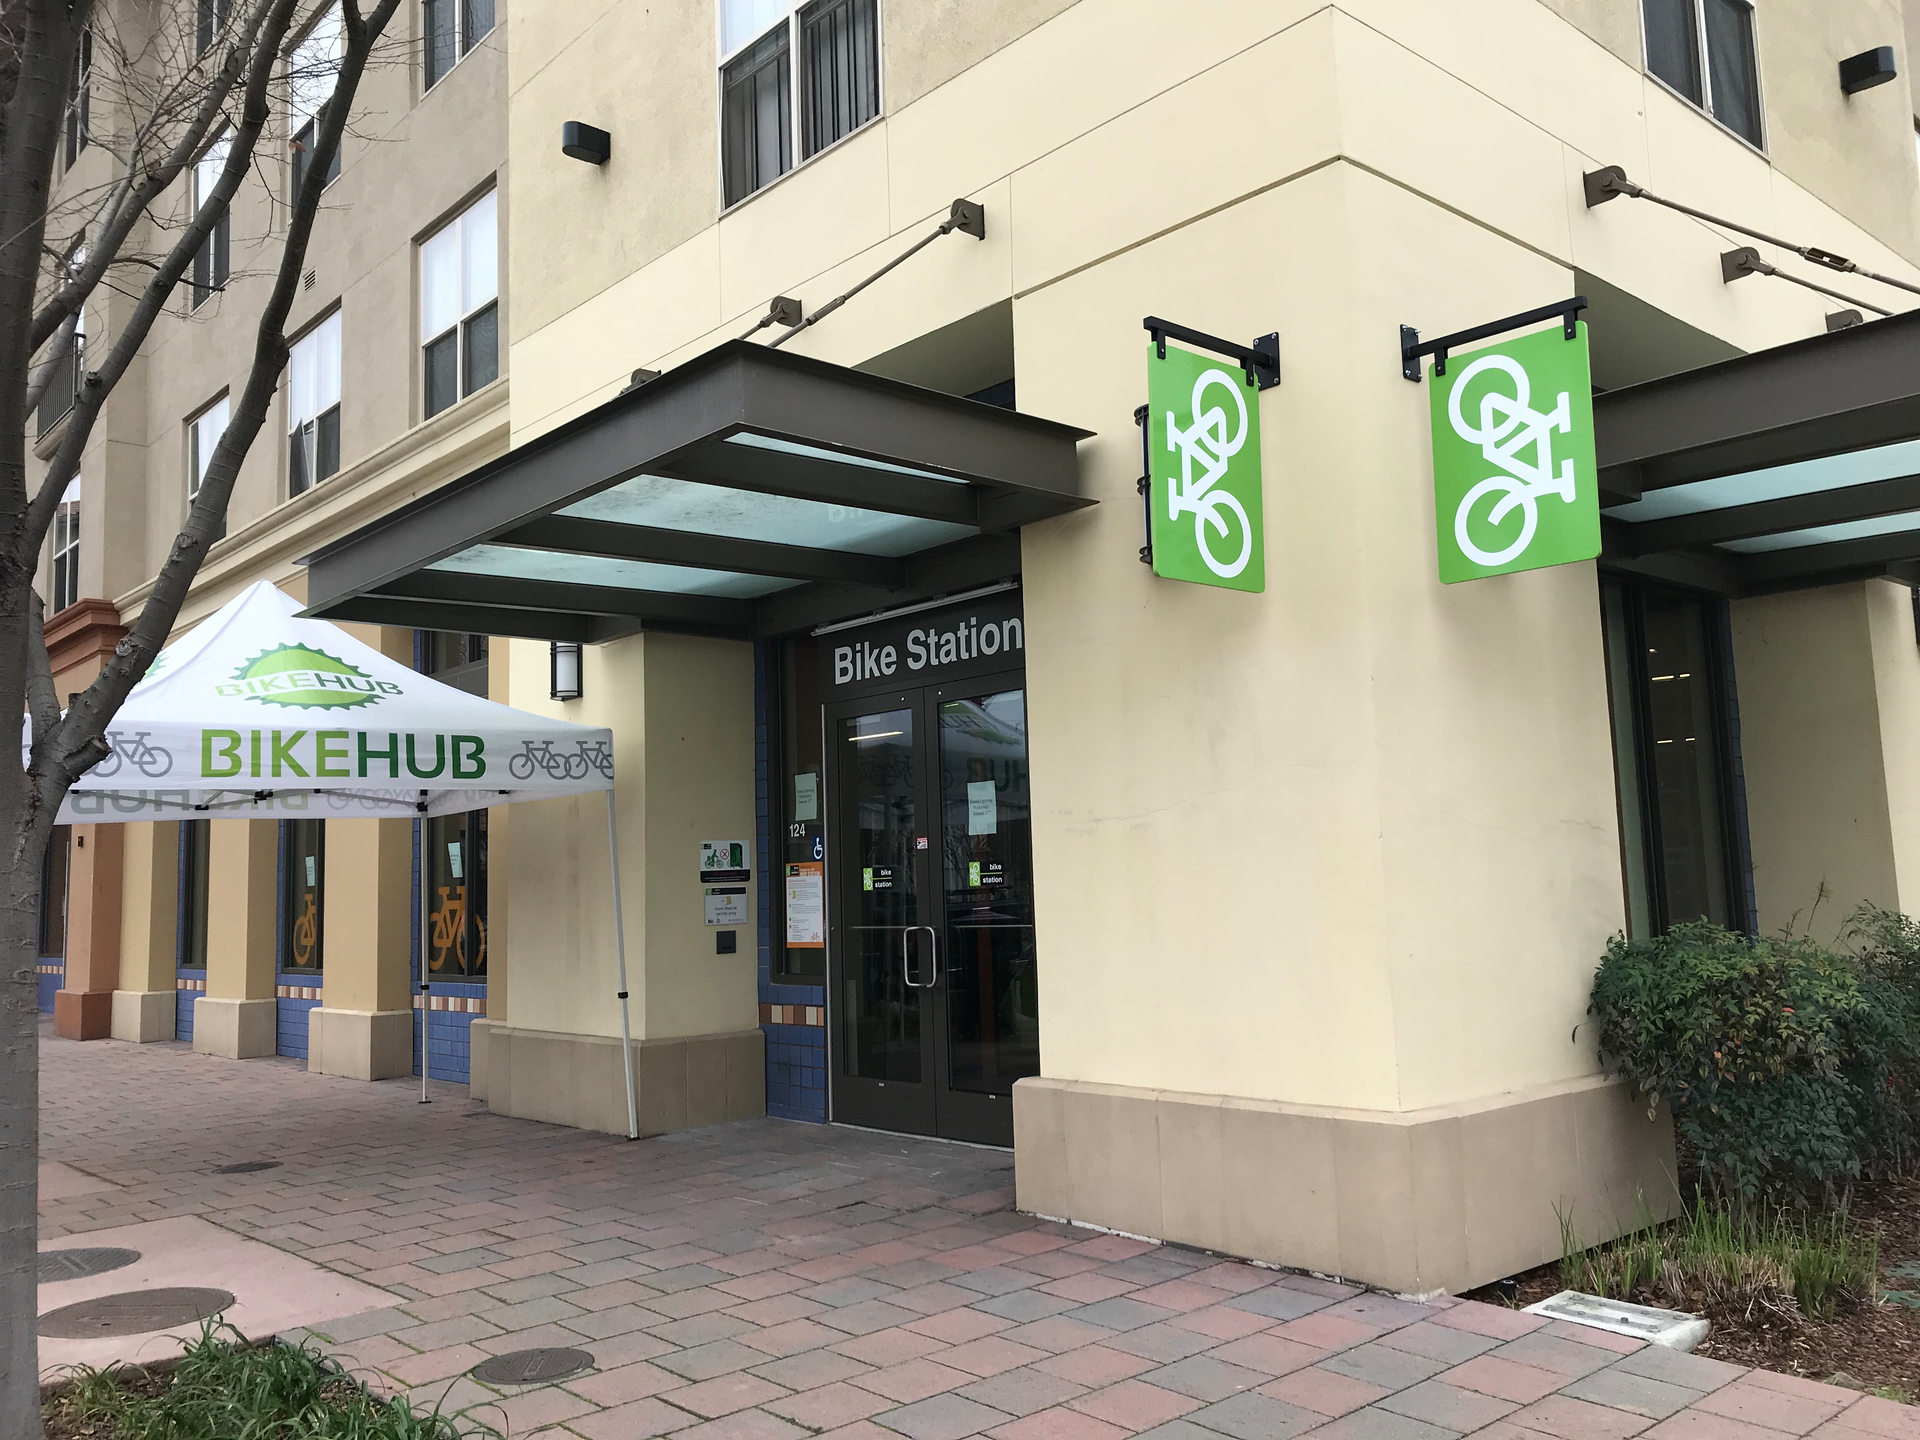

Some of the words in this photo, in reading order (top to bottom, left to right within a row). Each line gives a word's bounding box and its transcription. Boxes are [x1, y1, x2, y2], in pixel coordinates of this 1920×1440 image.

[834, 641, 897, 685] Bike
[906, 617, 1023, 671] Station
[214, 672, 404, 697] BIKEHUB
[201, 729, 487, 780] BIKEHUB
[789, 823, 806, 838] 124
[982, 876, 1003, 884] station
